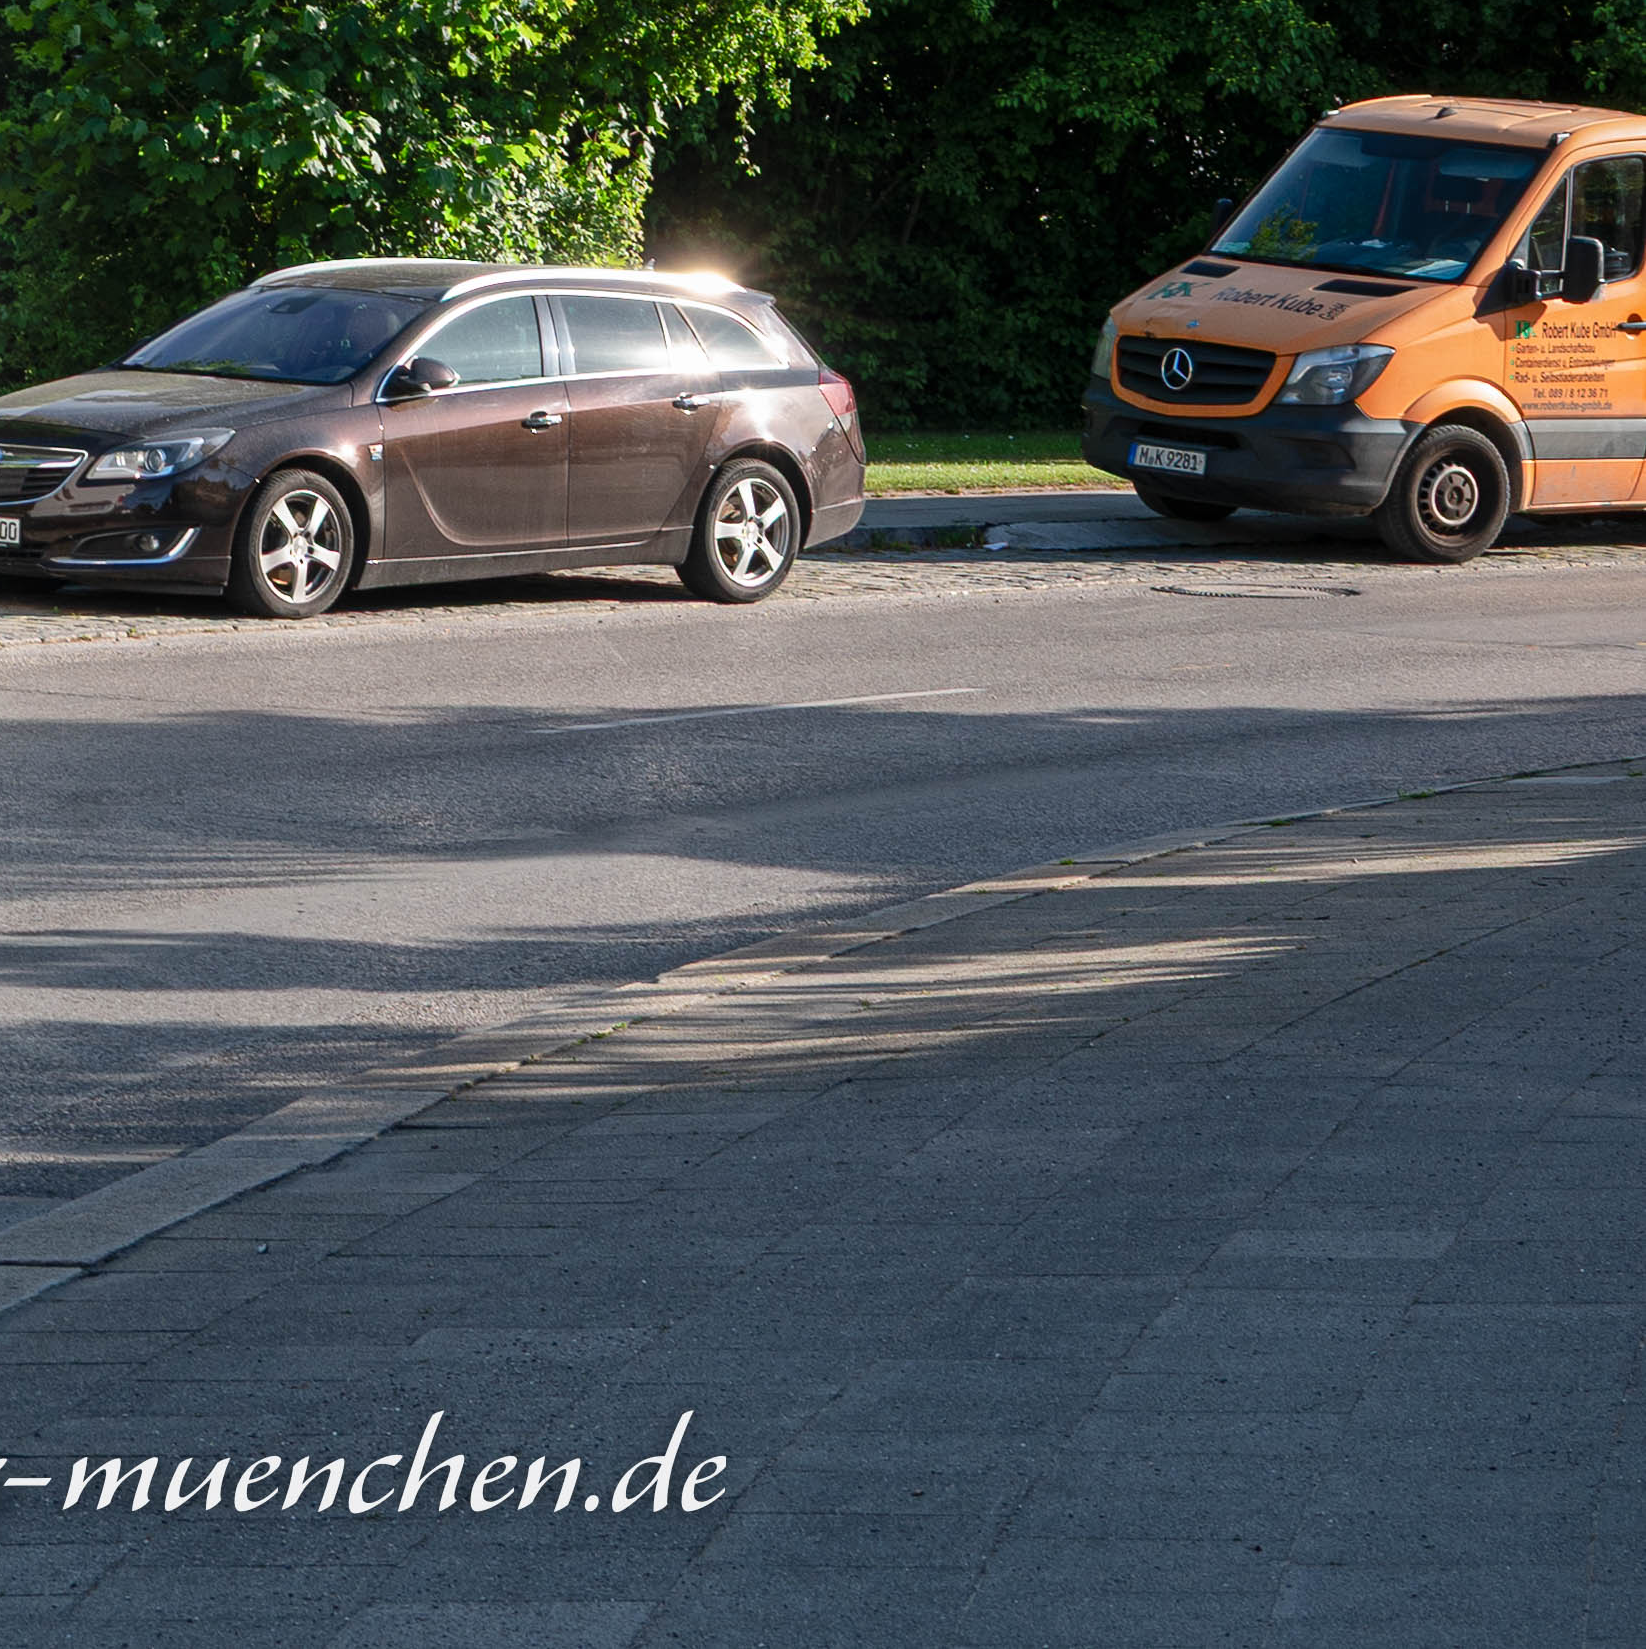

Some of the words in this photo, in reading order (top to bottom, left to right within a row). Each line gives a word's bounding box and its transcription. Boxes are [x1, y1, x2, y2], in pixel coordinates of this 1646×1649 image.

[1210, 286, 1278, 306] Robert
[1270, 293, 1324, 315] Kube
[1542, 321, 1569, 339] Robert
[1570, 321, 1590, 339] Kube
[1593, 321, 1617, 339] GmbH
[1532, 388, 1546, 398] Tel.
[1548, 388, 1563, 398] 089
[1577, 388, 1586, 398] 12
[1599, 388, 1608, 398] 71
[1167, 451, 1197, 471] 9281
